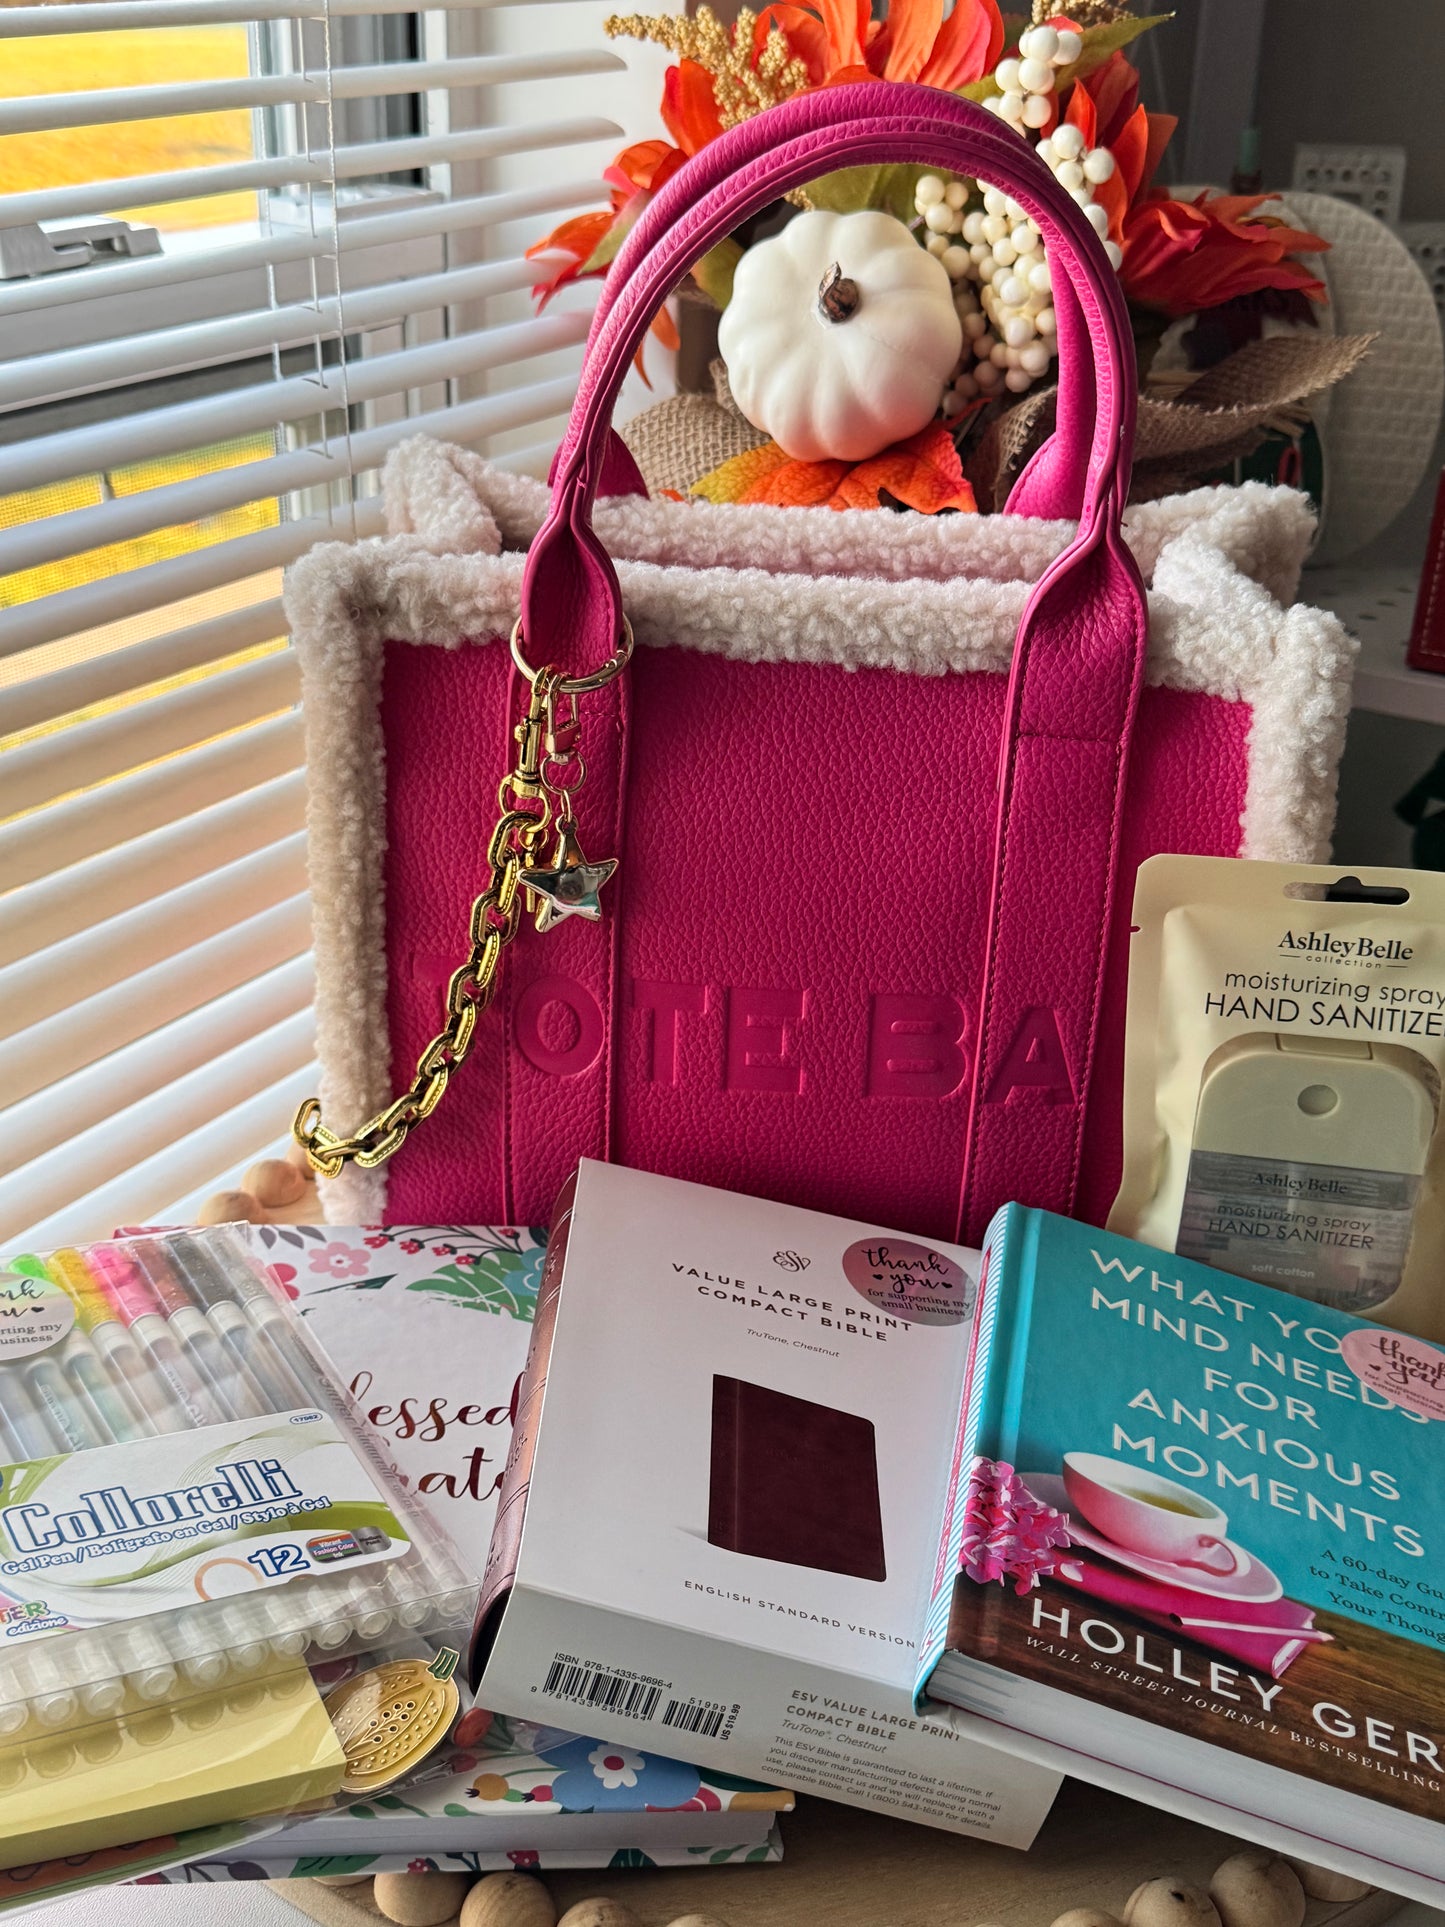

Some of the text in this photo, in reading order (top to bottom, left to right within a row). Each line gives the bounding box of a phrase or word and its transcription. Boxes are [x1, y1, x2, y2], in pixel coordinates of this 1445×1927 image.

[1306, 955, 1382, 969] collection
[1224, 971, 1445, 1010] moisturizing spray
[1205, 992, 1445, 1038] HAND SANITIZE
[1208, 1218, 1375, 1250] HAND SANITIZER
[1216, 1203, 1372, 1233] moisturizing spray
[861, 1246, 949, 1275] thank
[1251, 1263, 1316, 1279] soft cotton
[672, 1262, 913, 1331] VALUE LARGE PRINT
[867, 1288, 970, 1310] for supporting my
[890, 1273, 940, 1294] you
[1090, 1249, 1343, 1354] WHAT YO
[40, 1323, 62, 1332] my
[697, 1285, 888, 1342] COMPACT BIBLE
[881, 1300, 966, 1317] small business
[1091, 1286, 1230, 1352] MIND
[793, 1340, 840, 1358] Chestnut
[1204, 1366, 1321, 1430] FOR
[1128, 1388, 1401, 1501] ANXIOUS
[2, 1459, 303, 1553] Collorelli
[1112, 1423, 1425, 1557] MOMENTS
[1, 1557, 38, 1575] Gel
[37, 1551, 76, 1569] Pen
[173, 1525, 198, 1540] en
[196, 1516, 230, 1534] Gel
[240, 1506, 287, 1525] Stylo
[300, 1495, 333, 1512] Gel
[313, 1542, 355, 1556] Fashion Color
[247, 1543, 311, 1577] 12
[1321, 1549, 1337, 1562] A
[1342, 1555, 1410, 1589] 60-day
[1309, 1565, 1330, 1579] to
[1335, 1572, 1384, 1599] Take
[684, 1579, 916, 1649] ENGLISH STANDARD VERSION
[1327, 1590, 1376, 1617] Your
[554, 1652, 580, 1665] ISBN
[1032, 1597, 1284, 1712] HOLLEY
[688, 1696, 727, 1713] 51999
[719, 1703, 741, 1741] US $19.99
[786, 1704, 897, 1741] COMPACT BIBLE
[791, 1689, 819, 1704] ESV
[823, 1697, 868, 1717] VALUE
[871, 1710, 918, 1730] LARGE
[1026, 1636, 1441, 1792] WALL STREET JOURNAL BESTSELLING
[836, 1733, 888, 1754] Chestnut
[769, 1747, 1002, 1812] you discover manufacturing defects during normal
[774, 1735, 793, 1748] This
[795, 1741, 816, 1753] ESV
[817, 1747, 841, 1760] Bible
[843, 1754, 850, 1762] is
[852, 1757, 906, 1777] guaranteed
[907, 1770, 918, 1779] to
[920, 1774, 936, 1786] last
[985, 1790, 994, 1798] If
[761, 1765, 816, 1785] comparable
[846, 1786, 865, 1797] Call
[872, 1793, 900, 1807] (800)
[945, 1812, 959, 1822] for
[786, 1761, 817, 1776] please
[819, 1769, 853, 1785] contact
[868, 1783, 887, 1793] and
[889, 1789, 903, 1797] we
[905, 1792, 921, 1802] will
[922, 1796, 956, 1811] replace
[958, 1804, 966, 1812] it
[967, 1807, 988, 1819] with
